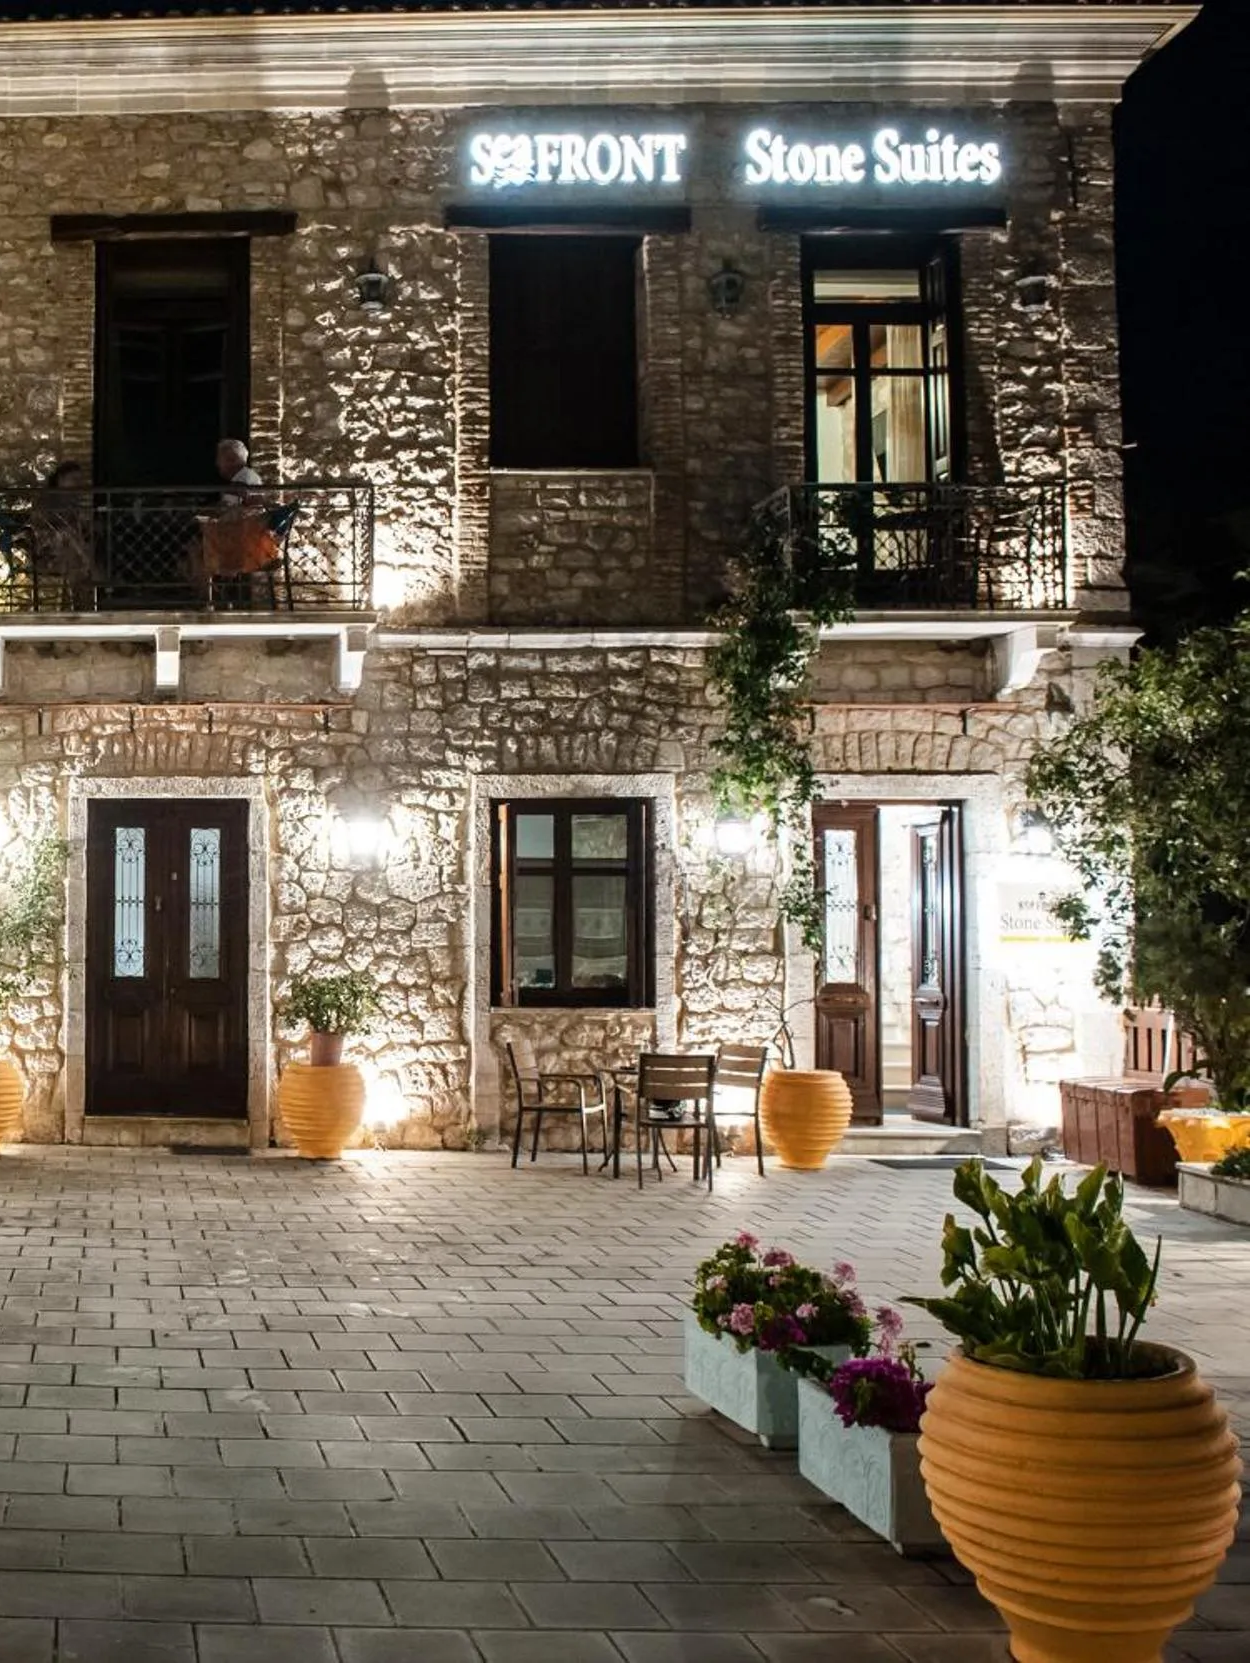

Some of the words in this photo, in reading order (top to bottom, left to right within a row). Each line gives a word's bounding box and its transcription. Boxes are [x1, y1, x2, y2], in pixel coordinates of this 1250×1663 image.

[745, 129, 865, 185] Stone
[873, 128, 1003, 184] Suites
[1000, 912, 1041, 931] Stone
